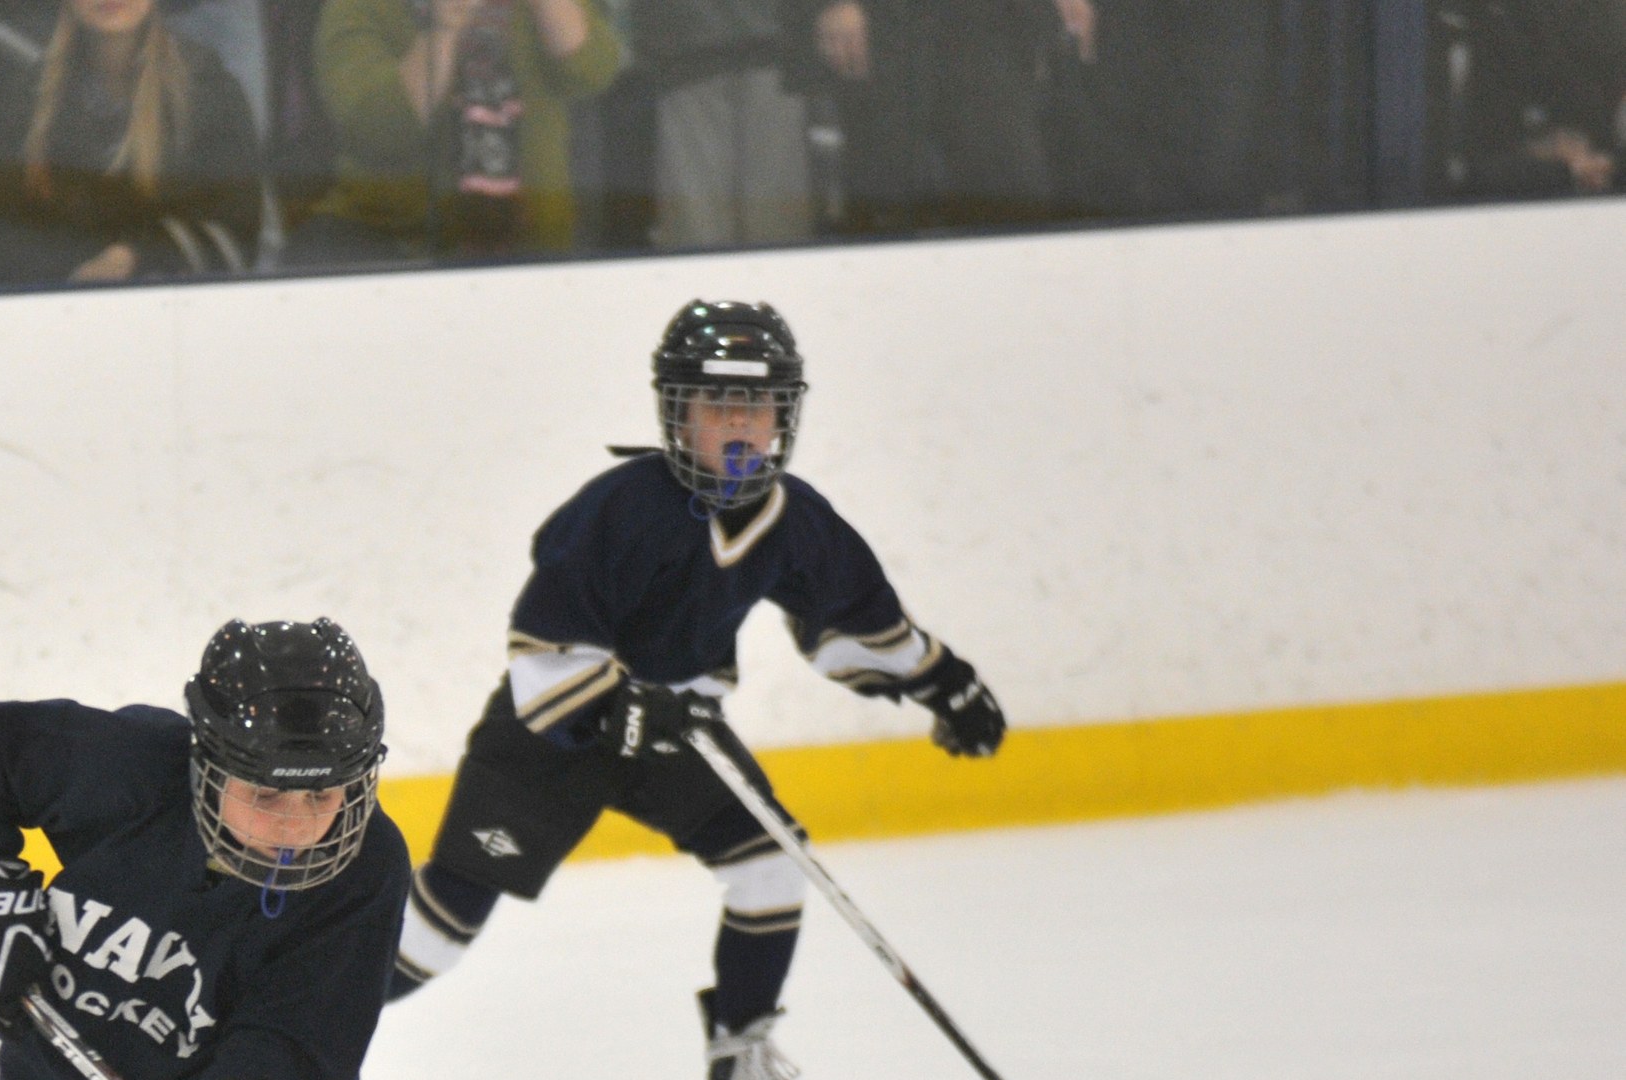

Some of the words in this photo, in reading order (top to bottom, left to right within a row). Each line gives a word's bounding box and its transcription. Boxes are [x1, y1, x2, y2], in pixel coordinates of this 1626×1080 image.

[620, 705, 642, 756] TON
[272, 767, 333, 777] BAUER
[44, 886, 217, 1043] NAVY
[50, 964, 200, 1059] OCKEY
